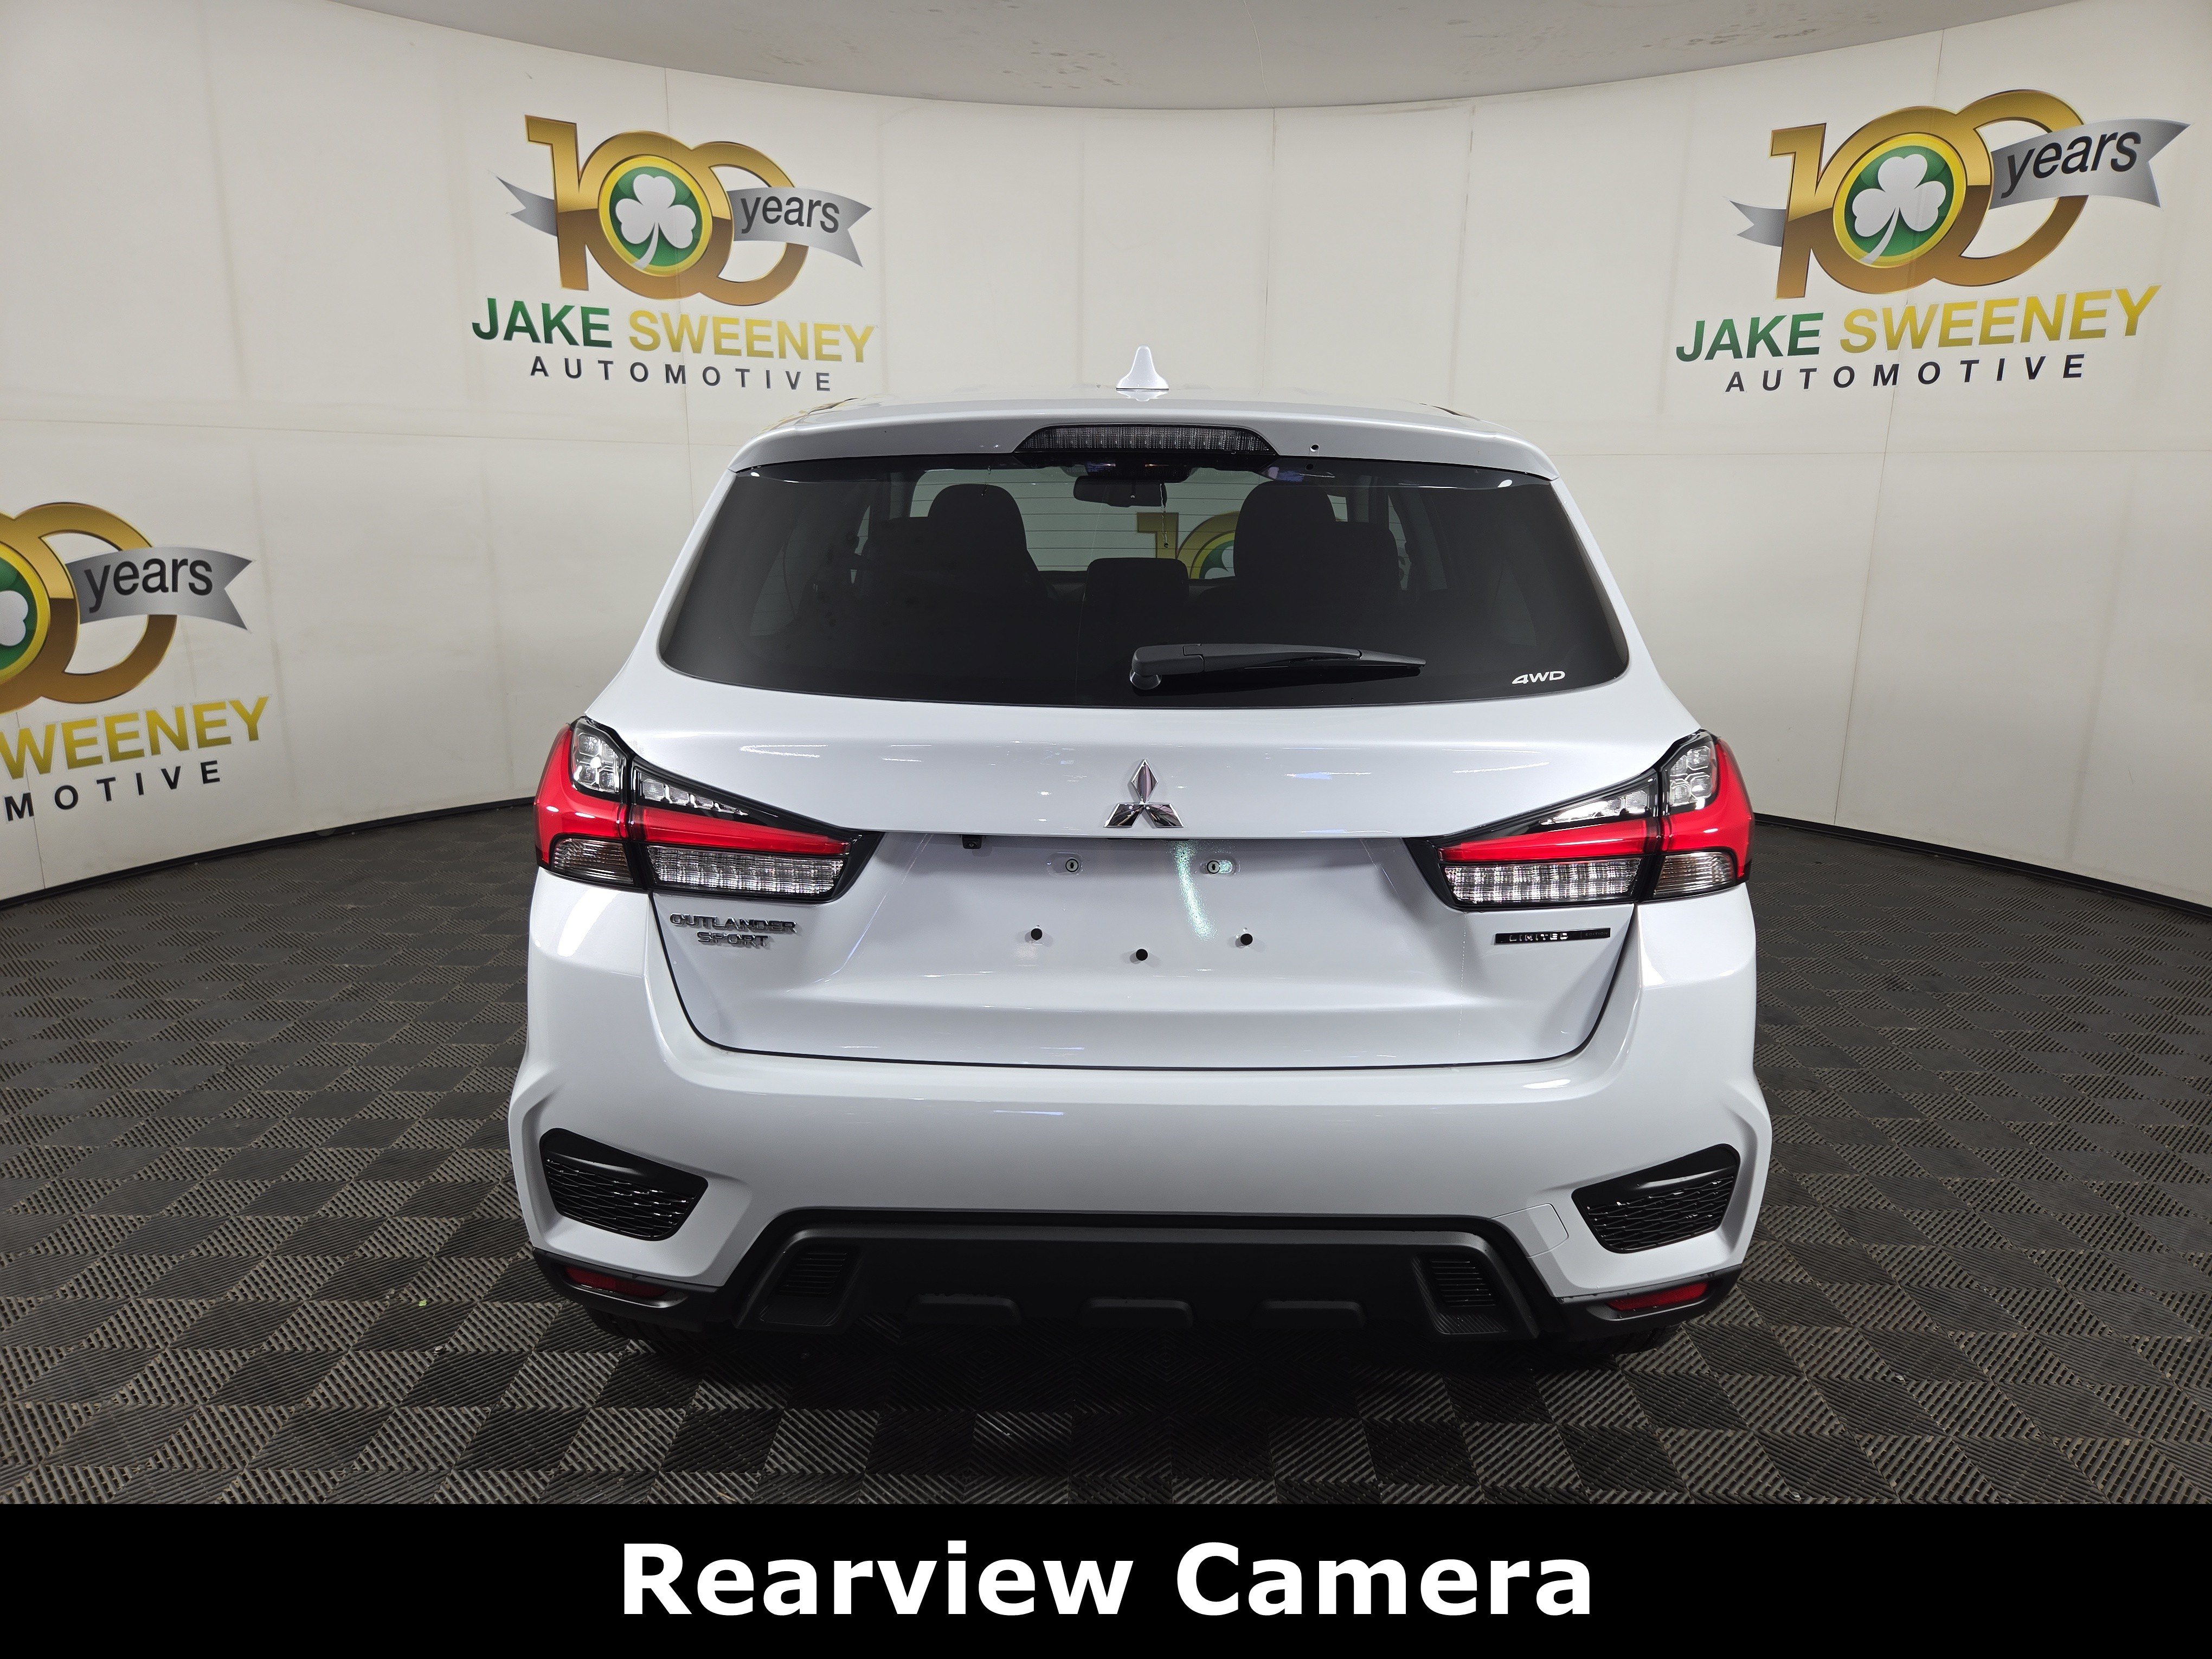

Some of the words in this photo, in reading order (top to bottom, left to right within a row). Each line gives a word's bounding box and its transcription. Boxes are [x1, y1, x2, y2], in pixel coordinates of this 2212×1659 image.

[524, 114, 809, 306] 100
[740, 192, 840, 234] years
[1769, 89, 2090, 300] 100
[2001, 130, 2142, 200] years
[472, 297, 613, 348] JAKE
[628, 309, 874, 363] SWEENEY
[1675, 312, 1825, 362] JAKE
[1839, 285, 2163, 354] SWEENEY
[530, 355, 831, 391] AUTOMOTIVE
[1725, 353, 2086, 394] AUTOMOTIVE
[83, 558, 214, 613] years
[1512, 671, 1566, 684] 4WD
[4, 760, 221, 821] MOTIVE
[670, 913, 798, 933] OUTLANDER
[697, 931, 769, 947] SPORT
